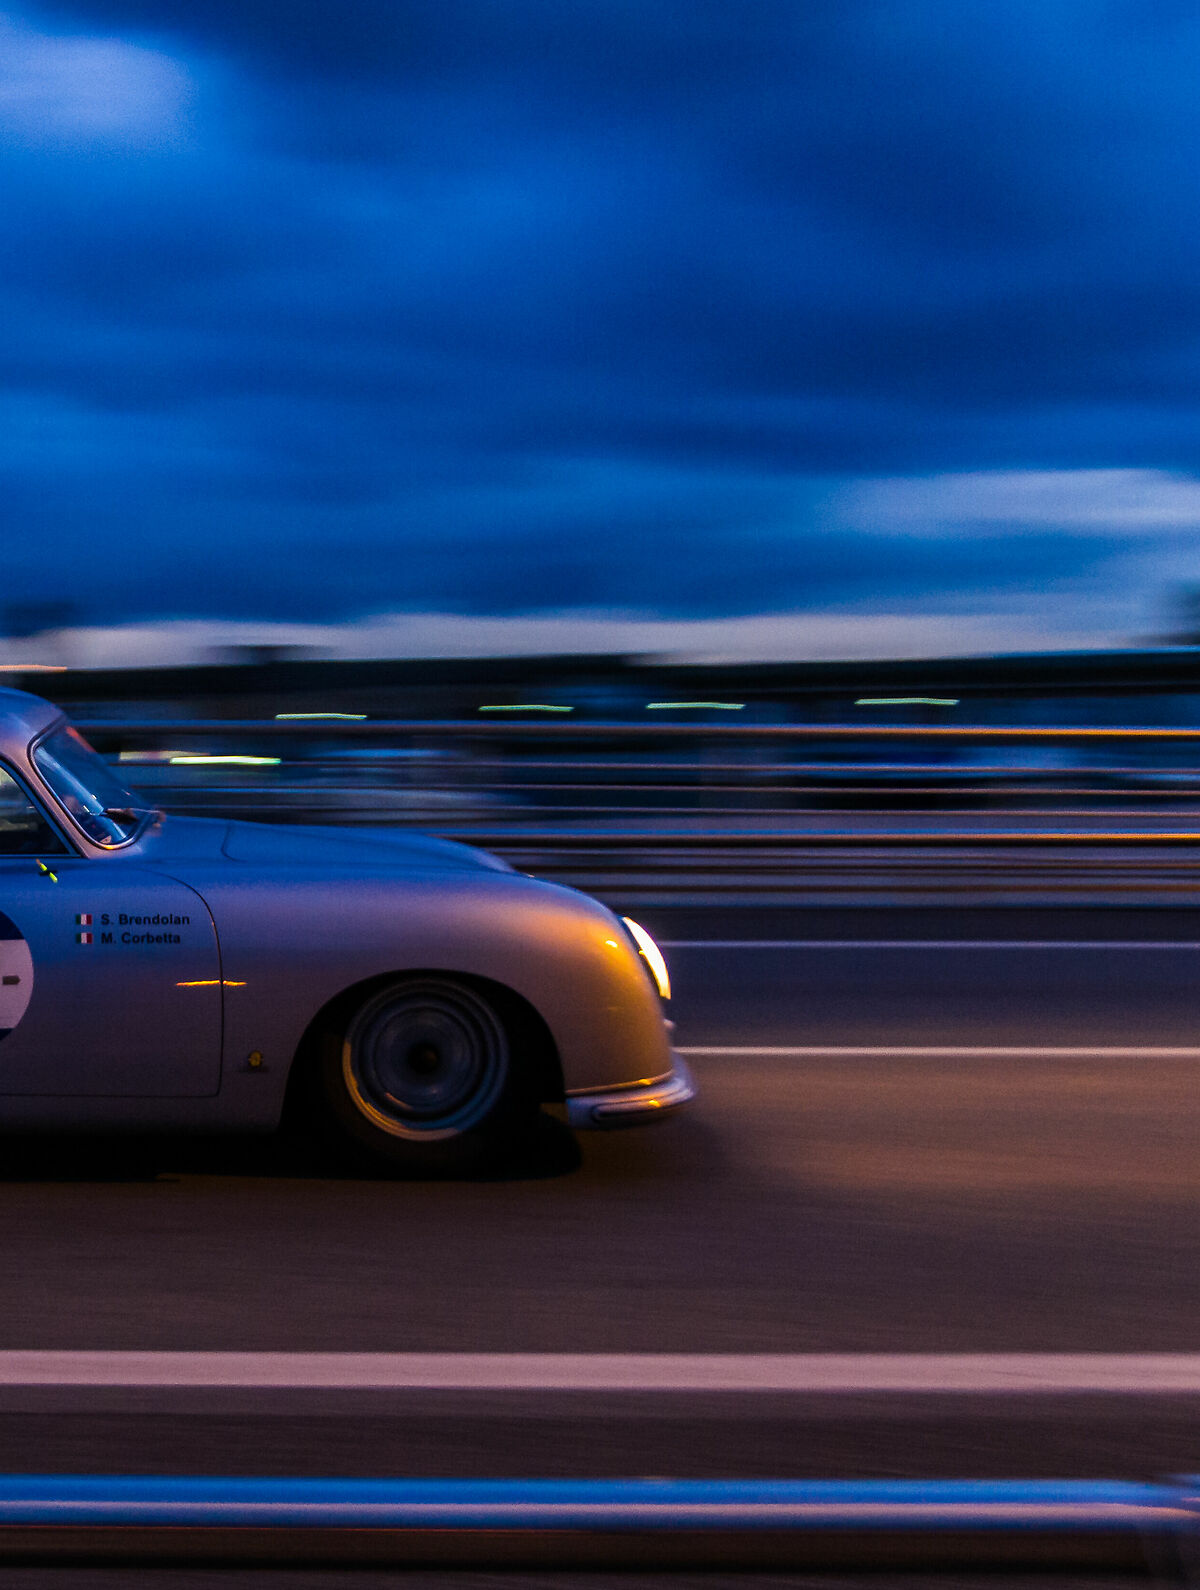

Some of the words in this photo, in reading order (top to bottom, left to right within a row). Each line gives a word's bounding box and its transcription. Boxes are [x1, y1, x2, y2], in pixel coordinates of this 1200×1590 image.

[101, 913, 114, 926] S.
[119, 913, 190, 926] Brendolan
[101, 932, 117, 944] M.
[121, 931, 181, 944] Corbetta
